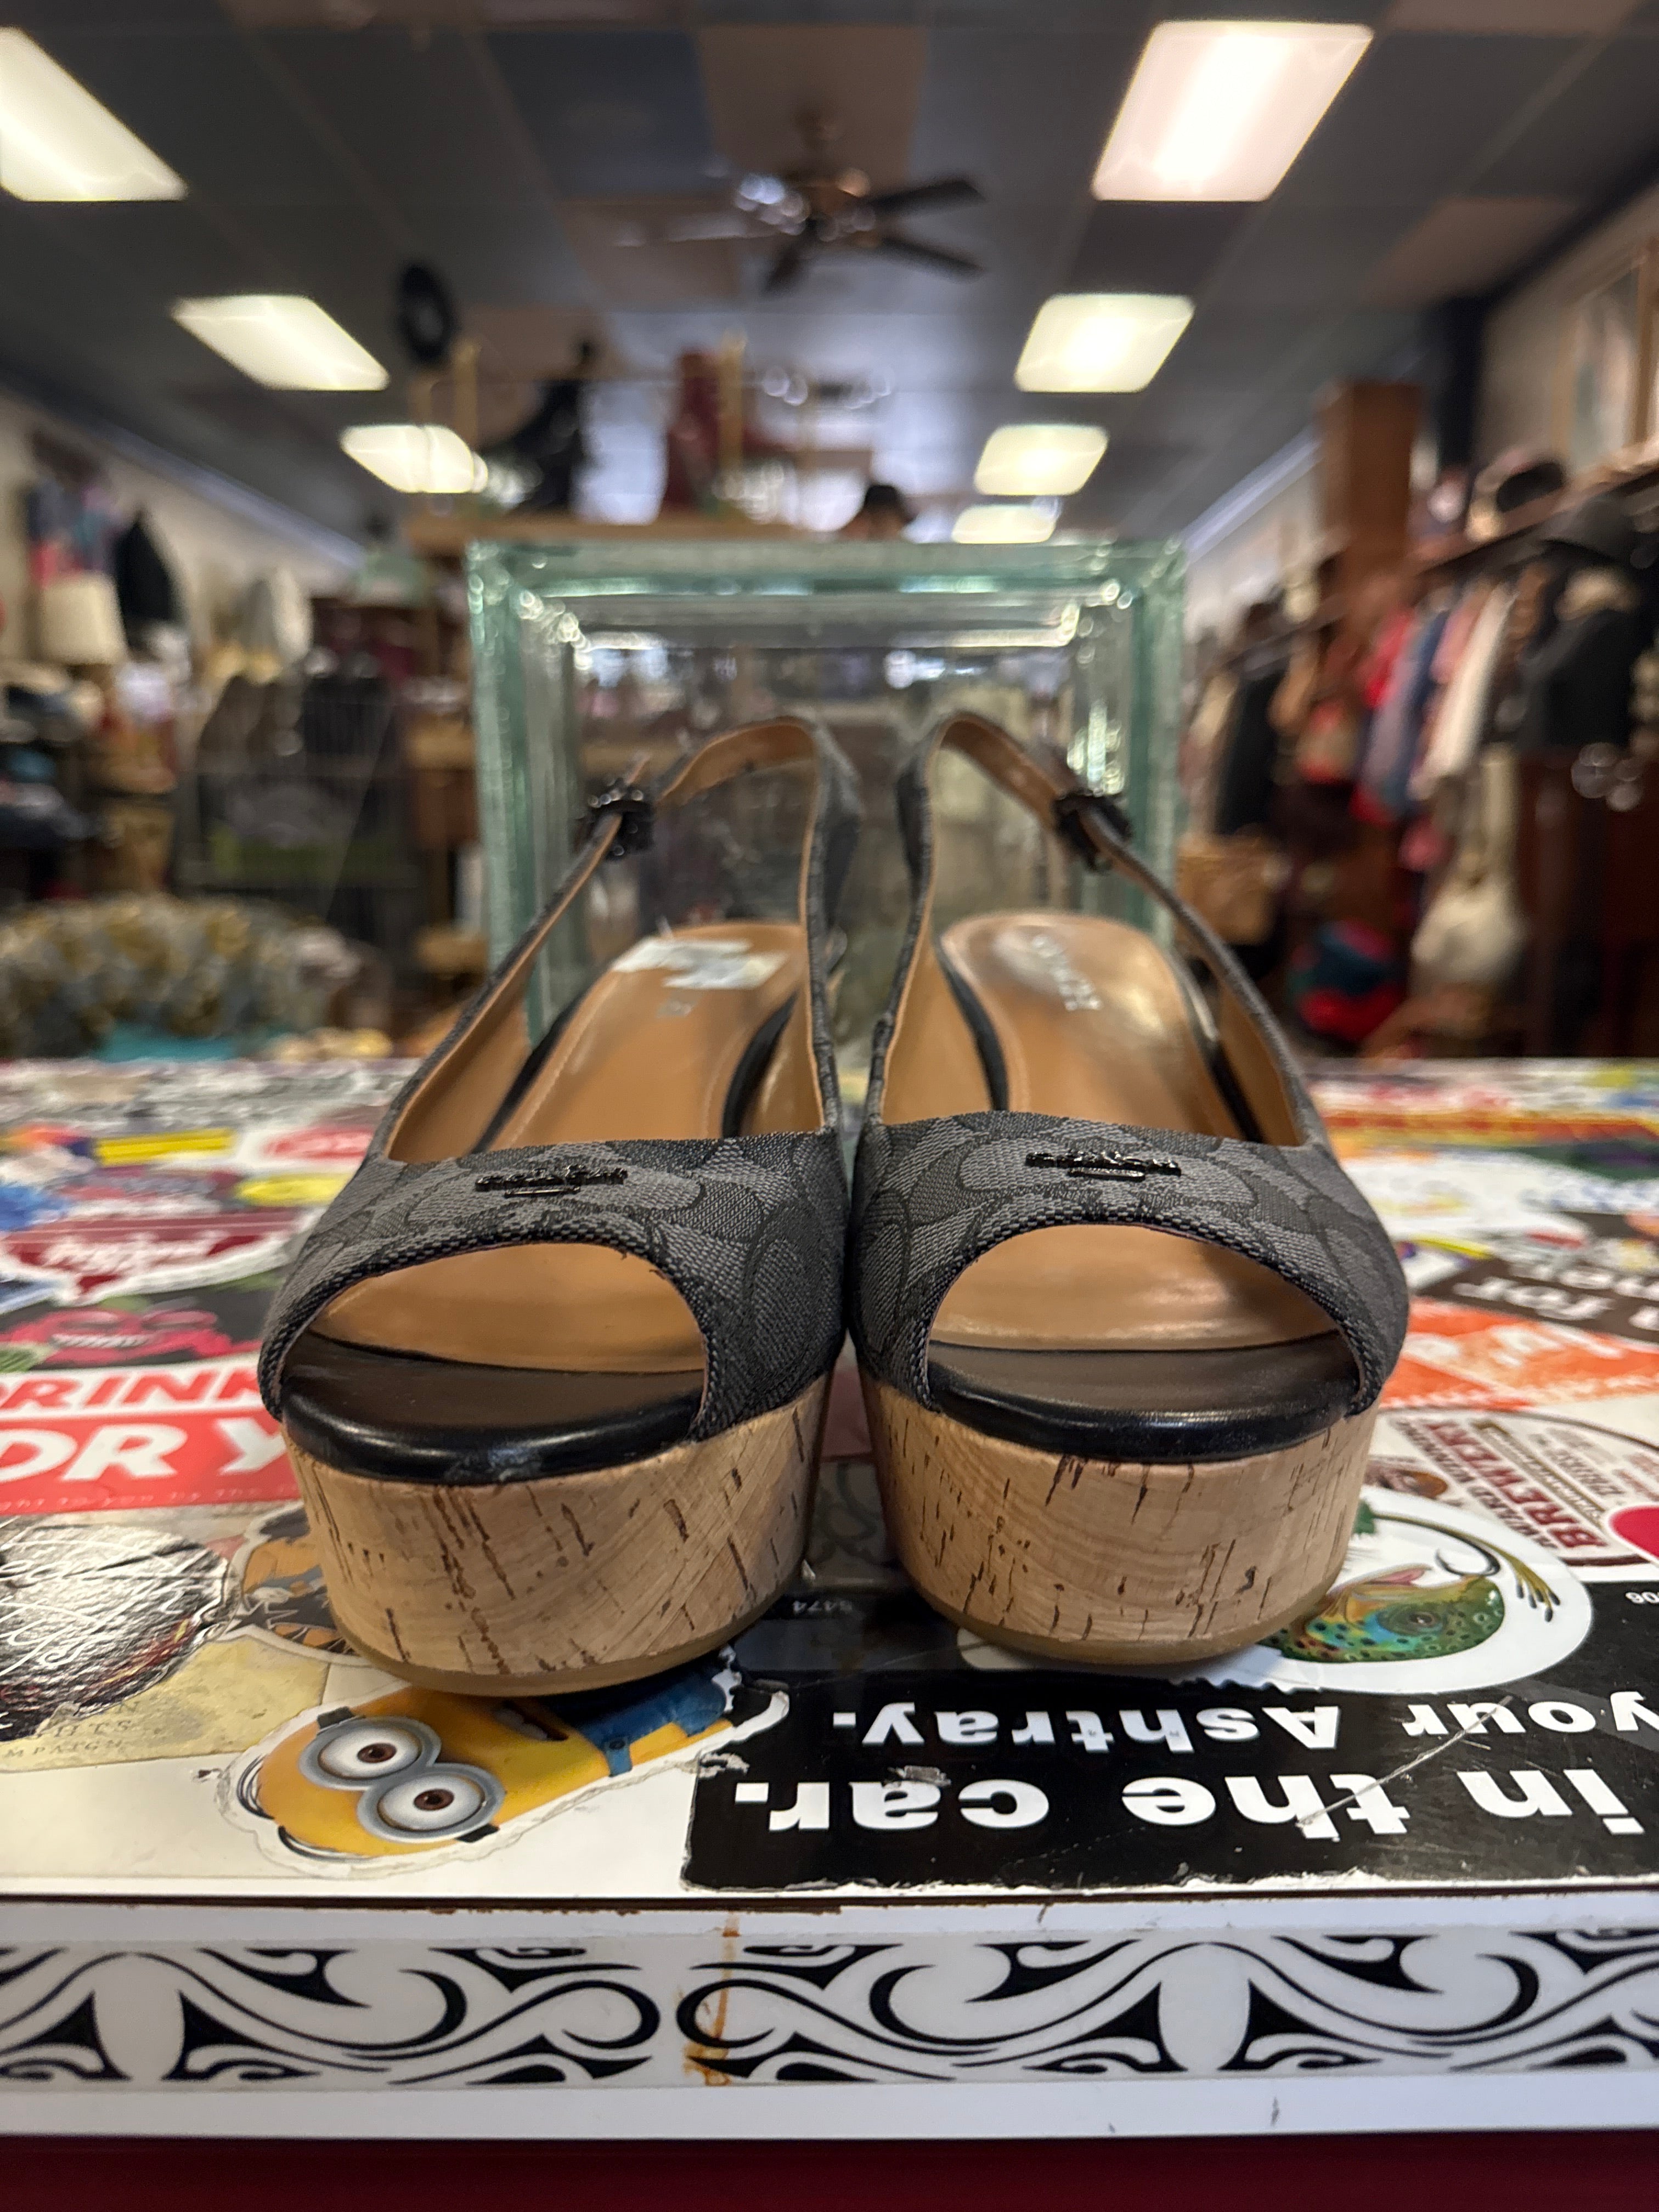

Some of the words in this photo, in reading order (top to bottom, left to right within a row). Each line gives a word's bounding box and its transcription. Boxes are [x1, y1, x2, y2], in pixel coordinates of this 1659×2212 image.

[0, 1368, 259, 1410] RINK
[832, 1701, 1340, 1753] Ashtray.
[1401, 1690, 1659, 1736] your
[6, 1739, 122, 1757] MPAIGN
[734, 1778, 1049, 1831] car.
[1121, 1773, 1411, 1839] the
[1456, 1769, 1645, 1835] in
